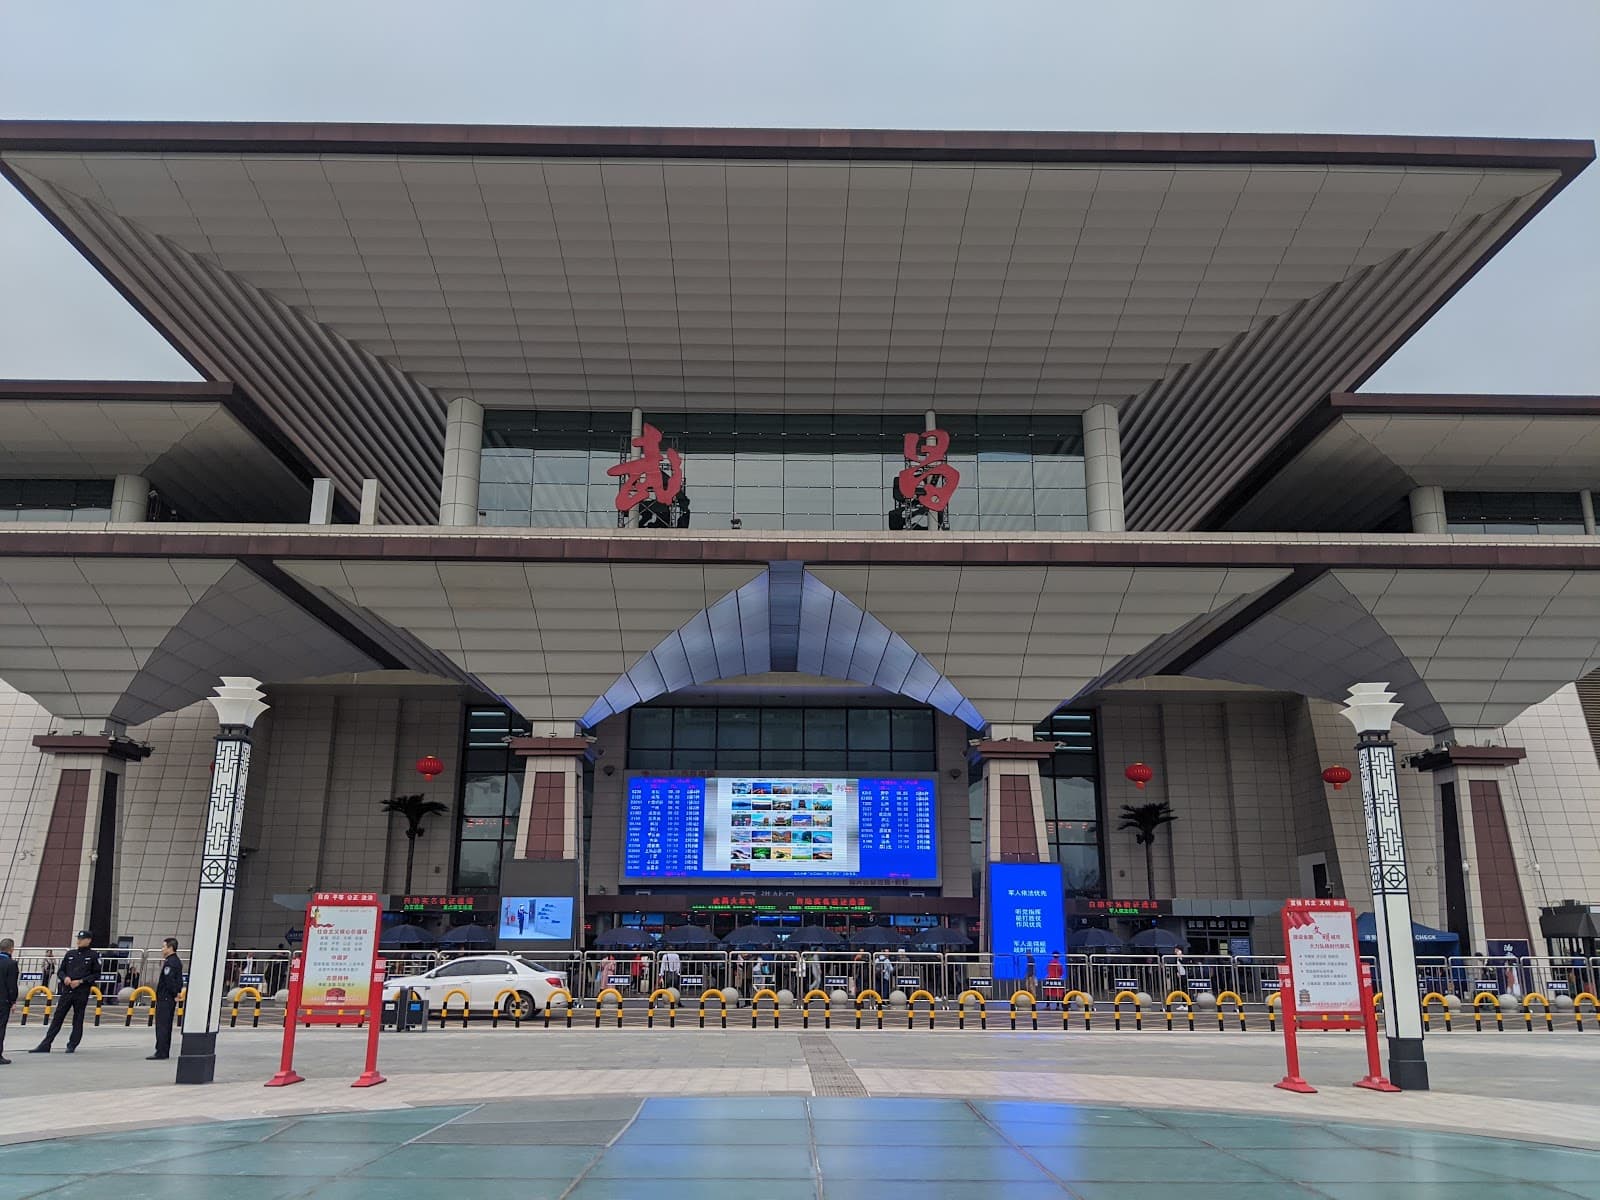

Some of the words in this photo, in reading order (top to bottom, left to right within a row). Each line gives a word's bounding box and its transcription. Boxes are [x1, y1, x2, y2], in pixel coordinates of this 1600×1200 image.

[607, 423, 681, 512] 武
[899, 429, 960, 512] 昌
[1008, 889, 1047, 897] 军人依法优先
